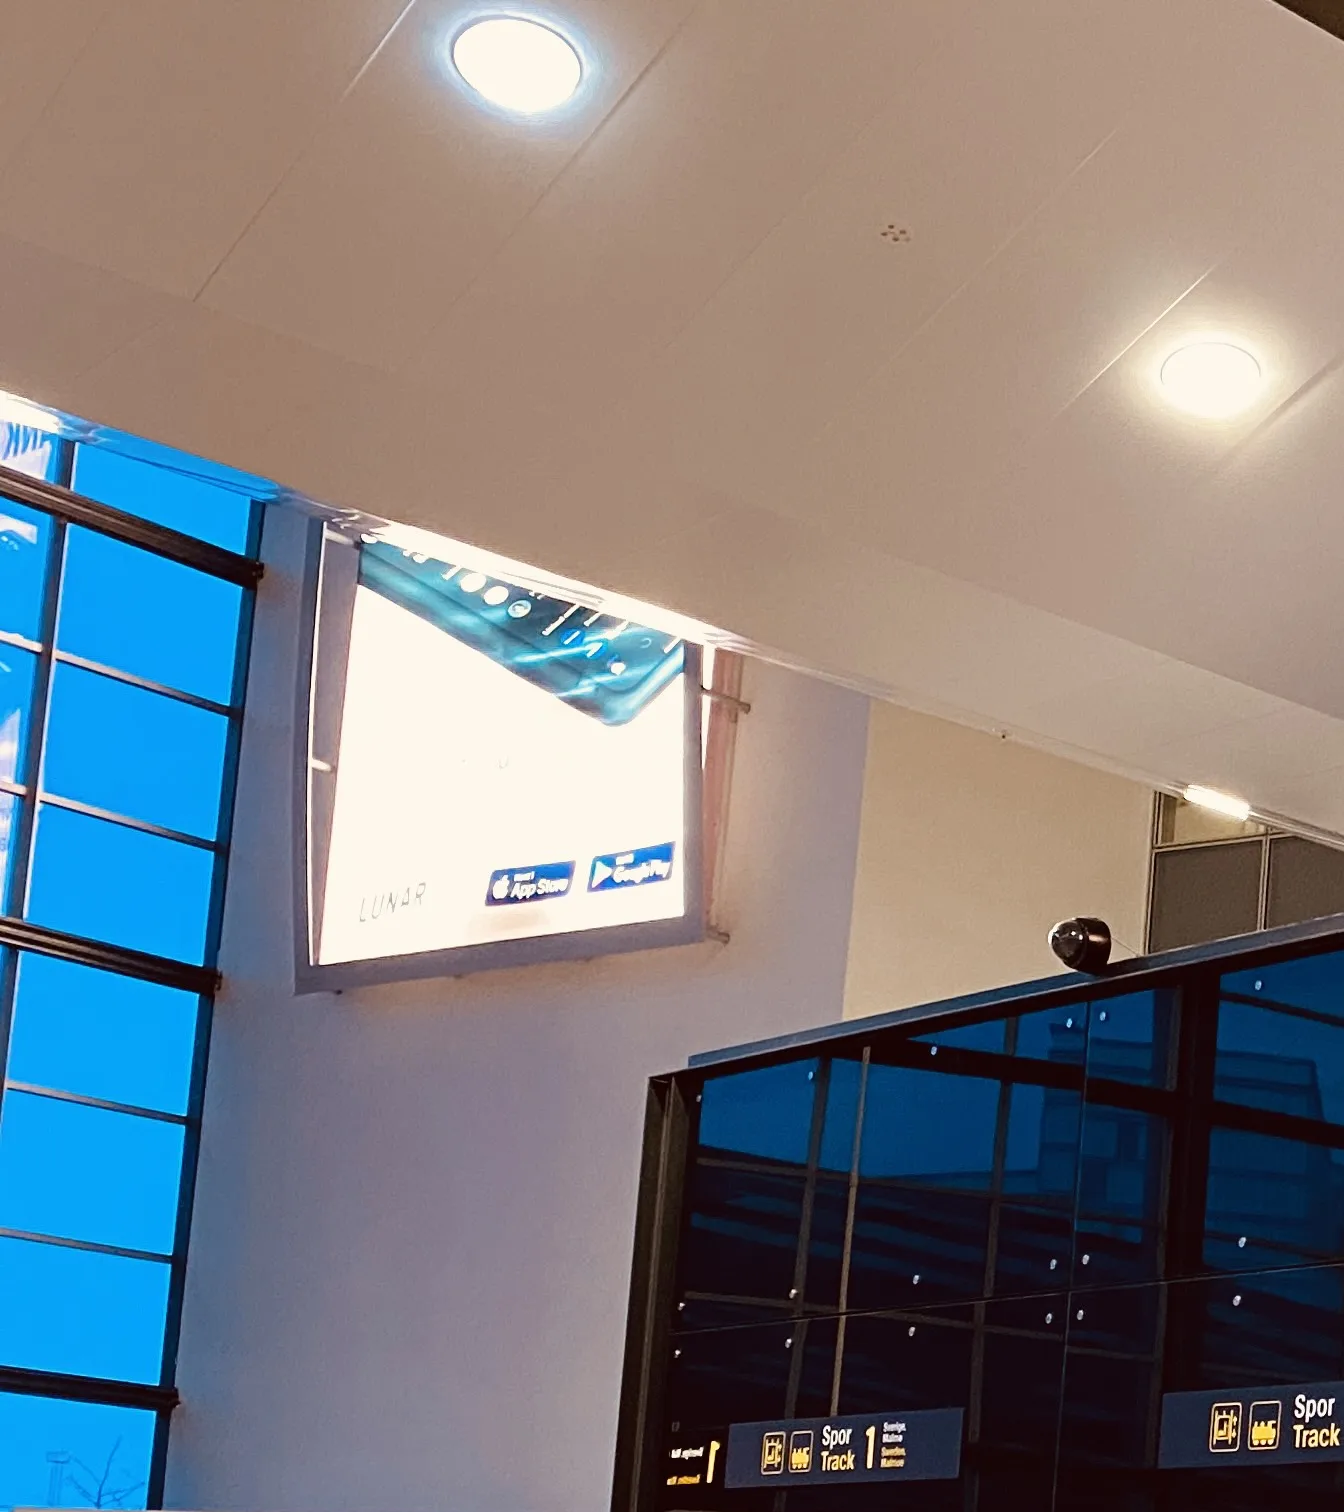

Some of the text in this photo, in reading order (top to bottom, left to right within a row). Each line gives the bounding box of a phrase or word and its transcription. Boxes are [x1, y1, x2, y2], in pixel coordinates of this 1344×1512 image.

[358, 880, 428, 923] LUNAR
[1293, 1393, 1336, 1423] Spor
[821, 1424, 853, 1450] Spor
[865, 1425, 876, 1469] 1
[1292, 1421, 1341, 1449] Track
[820, 1450, 855, 1472] Track
